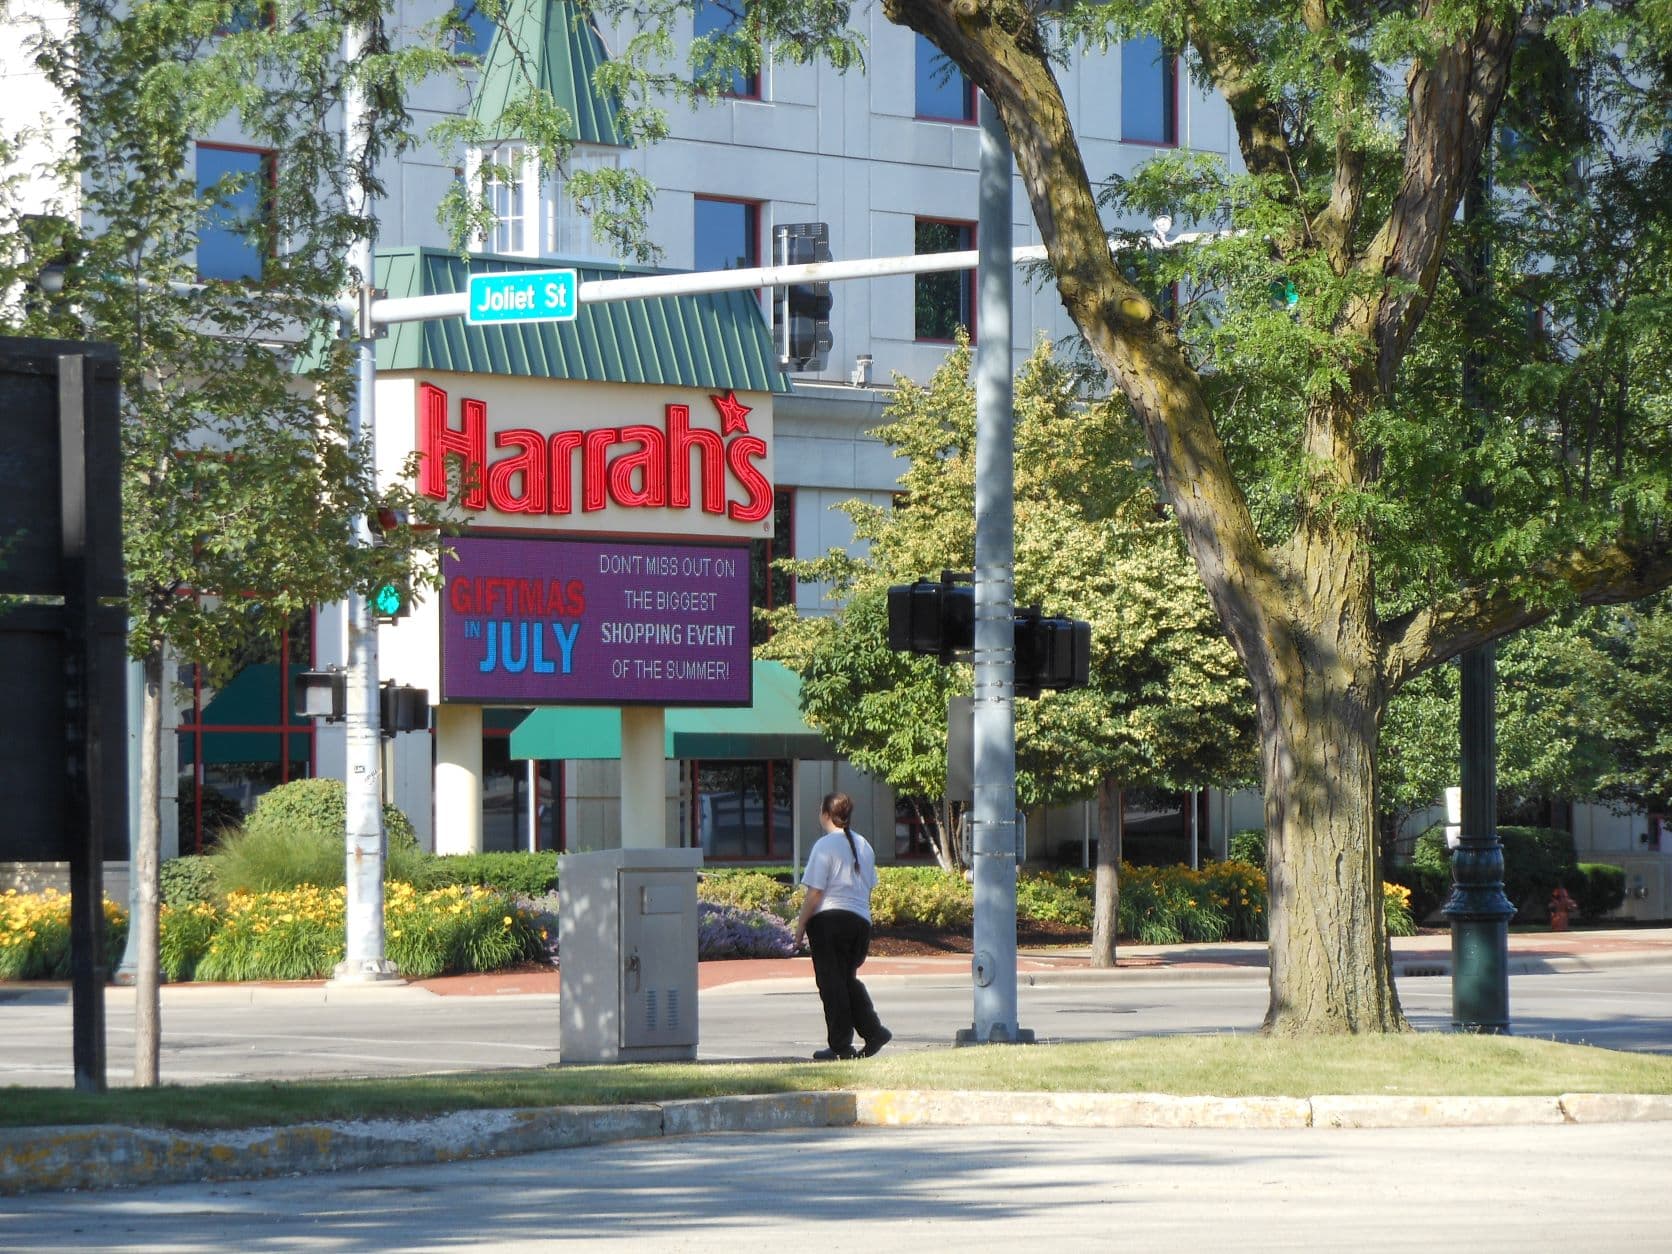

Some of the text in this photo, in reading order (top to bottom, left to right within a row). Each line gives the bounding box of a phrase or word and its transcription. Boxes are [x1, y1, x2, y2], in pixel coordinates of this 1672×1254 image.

[477, 283, 567, 312] Joliet St
[600, 555, 736, 577] DON'T MISS OUT ON
[451, 576, 586, 618] GIFTMAS
[625, 590, 717, 611] THE BIGGEST
[601, 622, 736, 646] SHOPPING EVENT
[464, 620, 582, 675] IN JULY
[612, 660, 730, 681] OF THE SUMMER!
